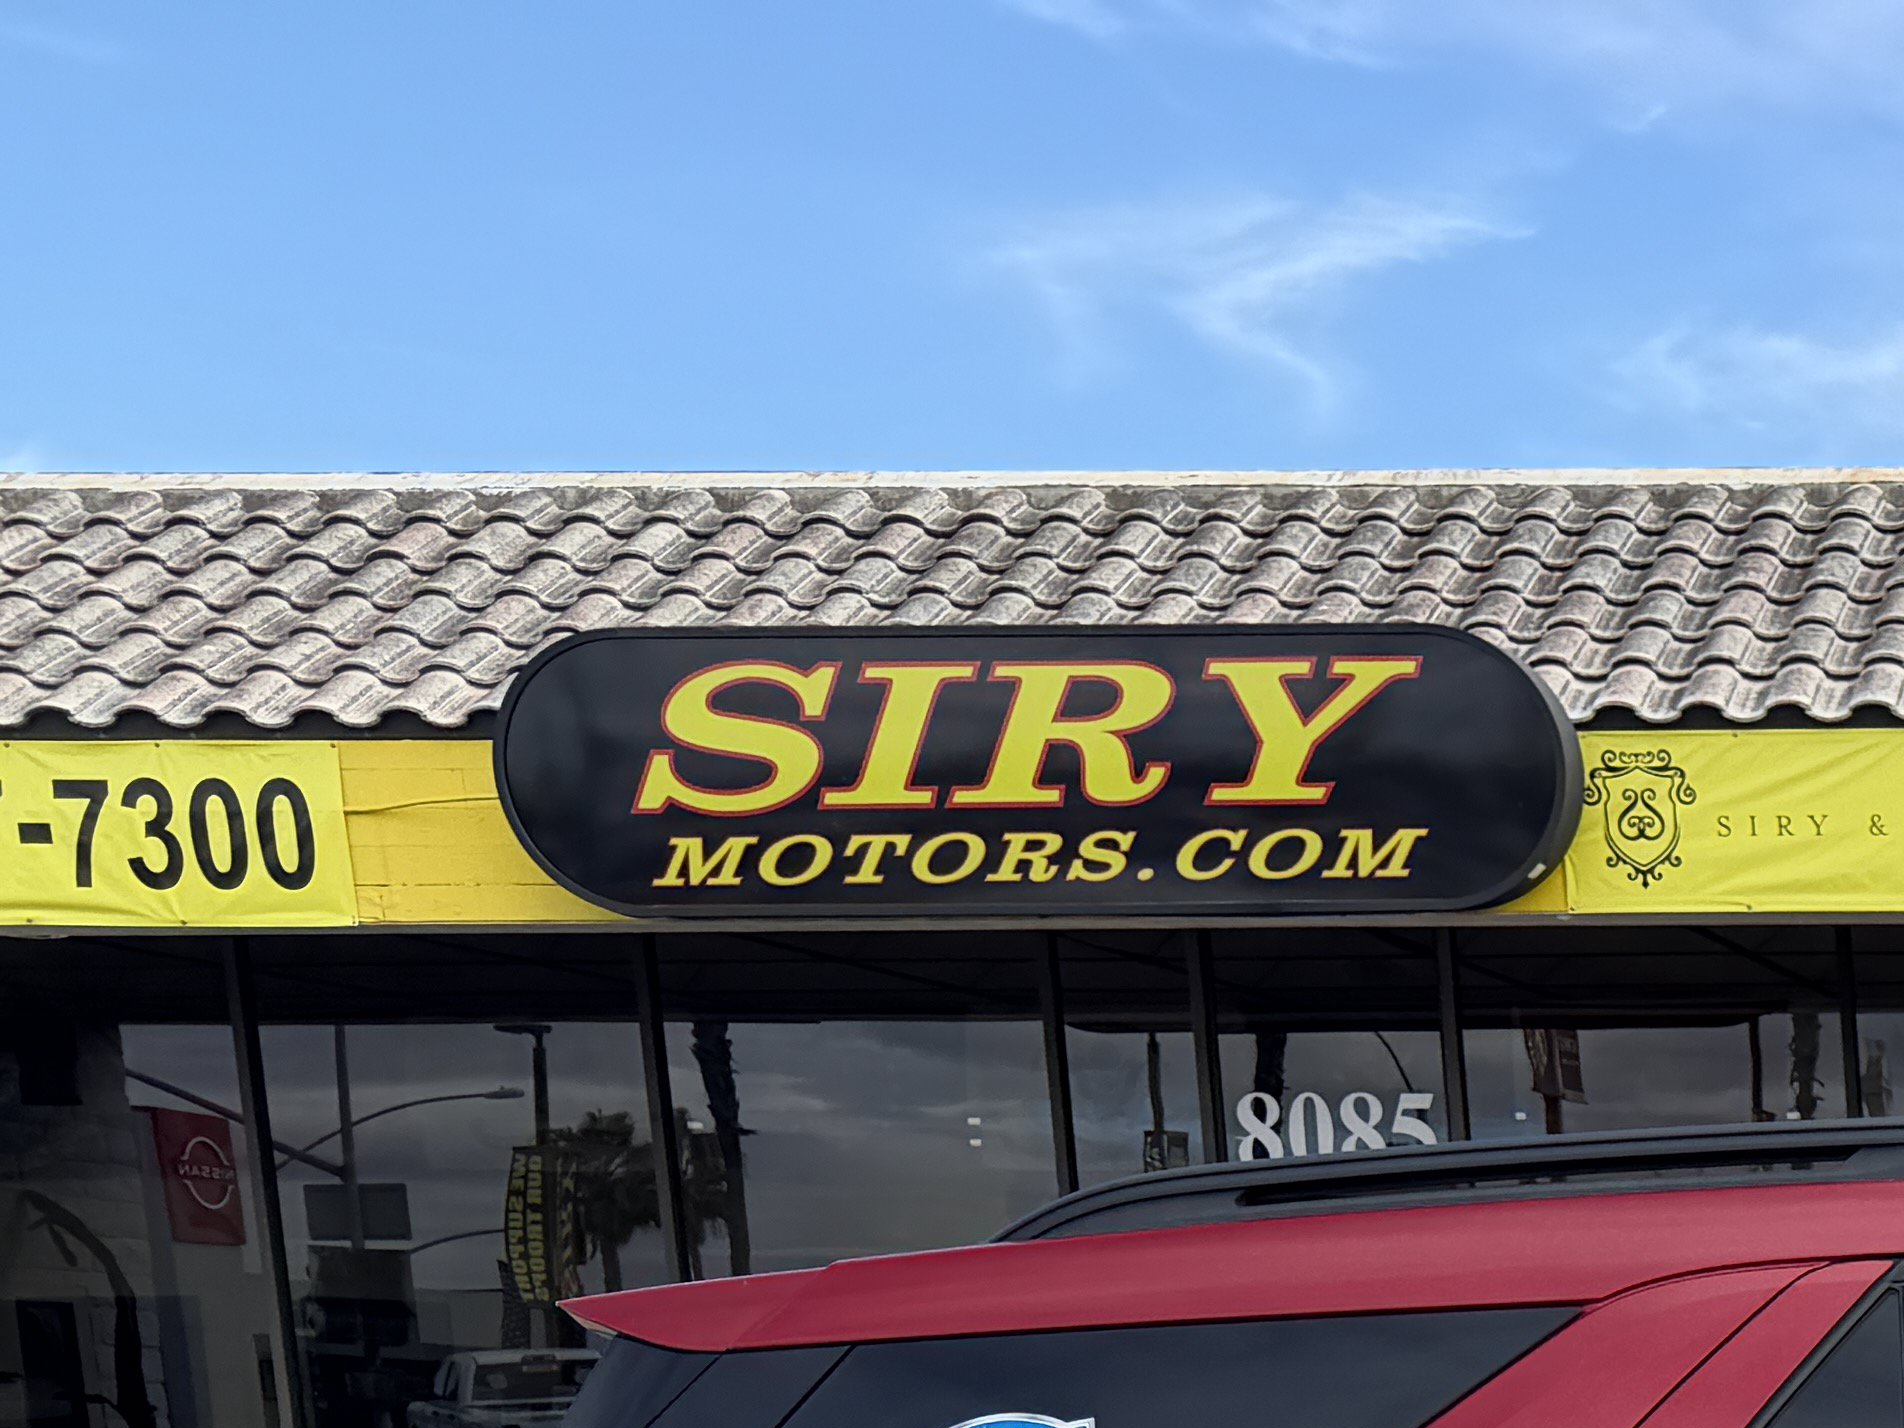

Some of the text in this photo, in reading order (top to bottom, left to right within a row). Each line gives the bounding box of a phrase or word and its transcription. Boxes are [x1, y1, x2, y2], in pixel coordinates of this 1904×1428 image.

[631, 655, 1423, 815] SIRY
[652, 828, 1428, 888] MOTORS.COM
[1716, 814, 1830, 838] SIRY
[1868, 813, 1890, 837] &
[1234, 1091, 1437, 1162] 8085
